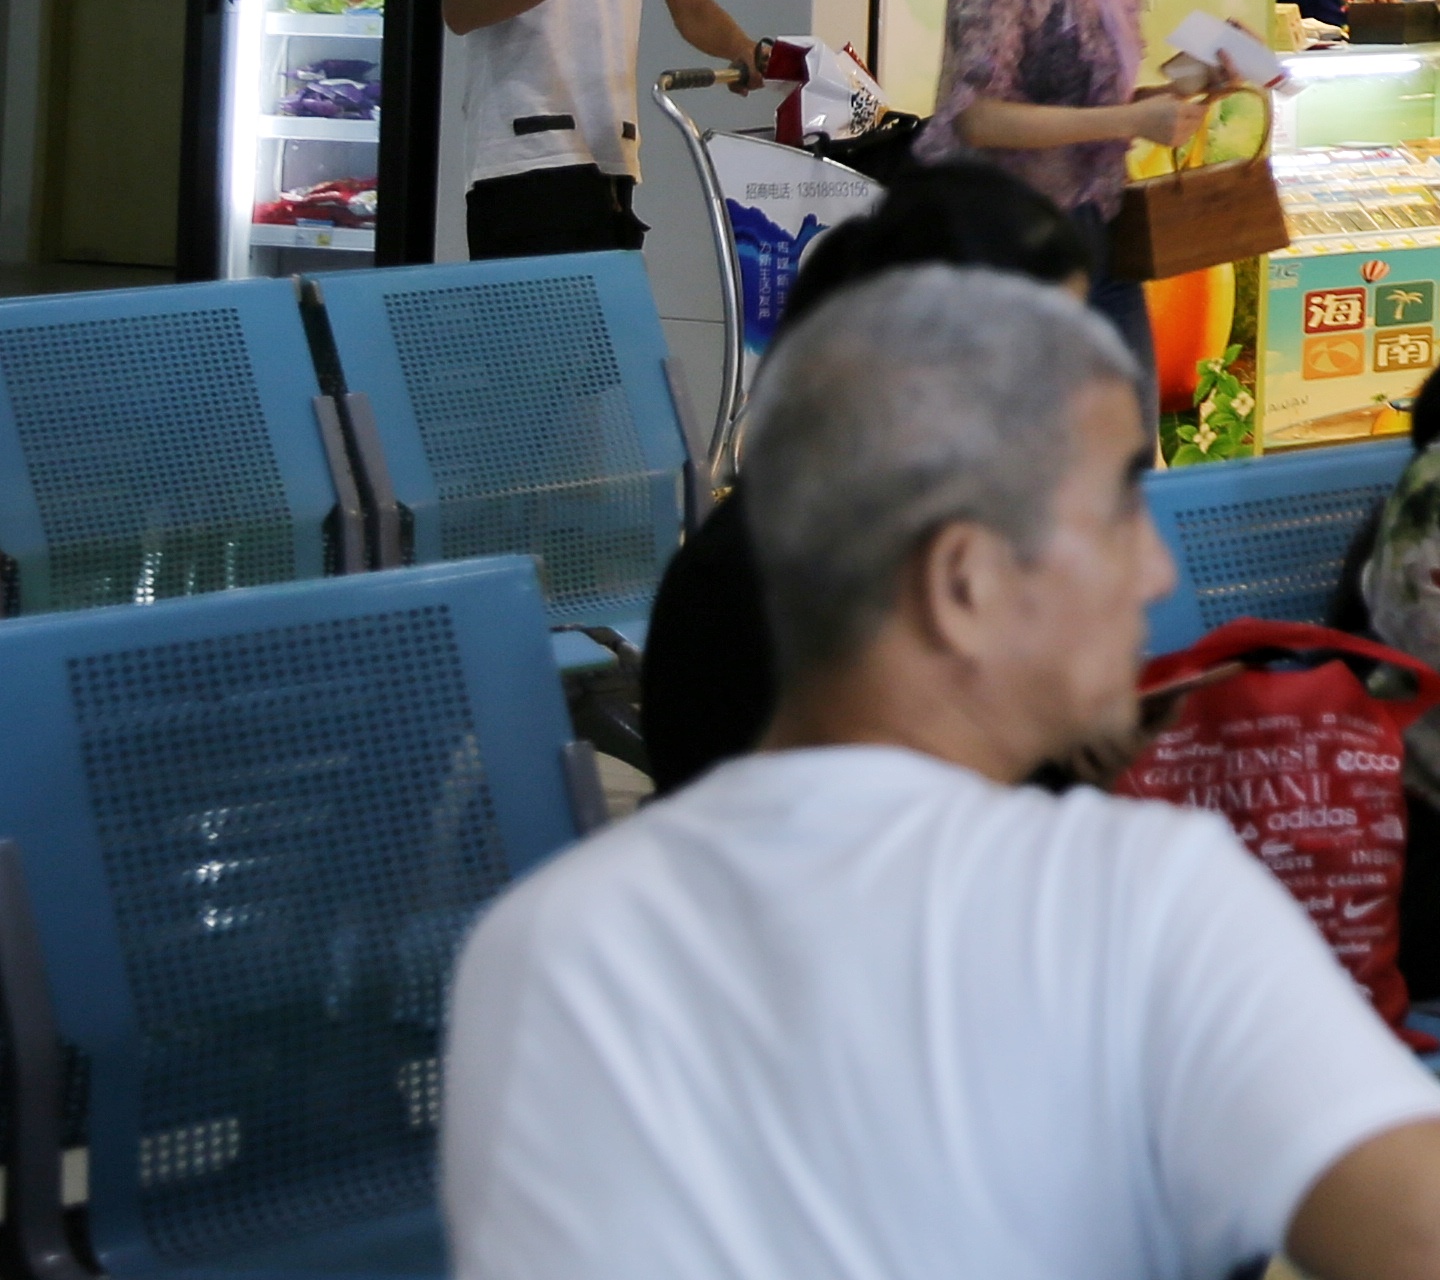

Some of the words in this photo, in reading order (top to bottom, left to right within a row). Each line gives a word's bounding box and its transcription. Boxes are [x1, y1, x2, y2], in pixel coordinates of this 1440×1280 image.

[1308, 293, 1363, 328] 海
[1376, 334, 1431, 367] 南
[1267, 807, 1358, 831] adidas
